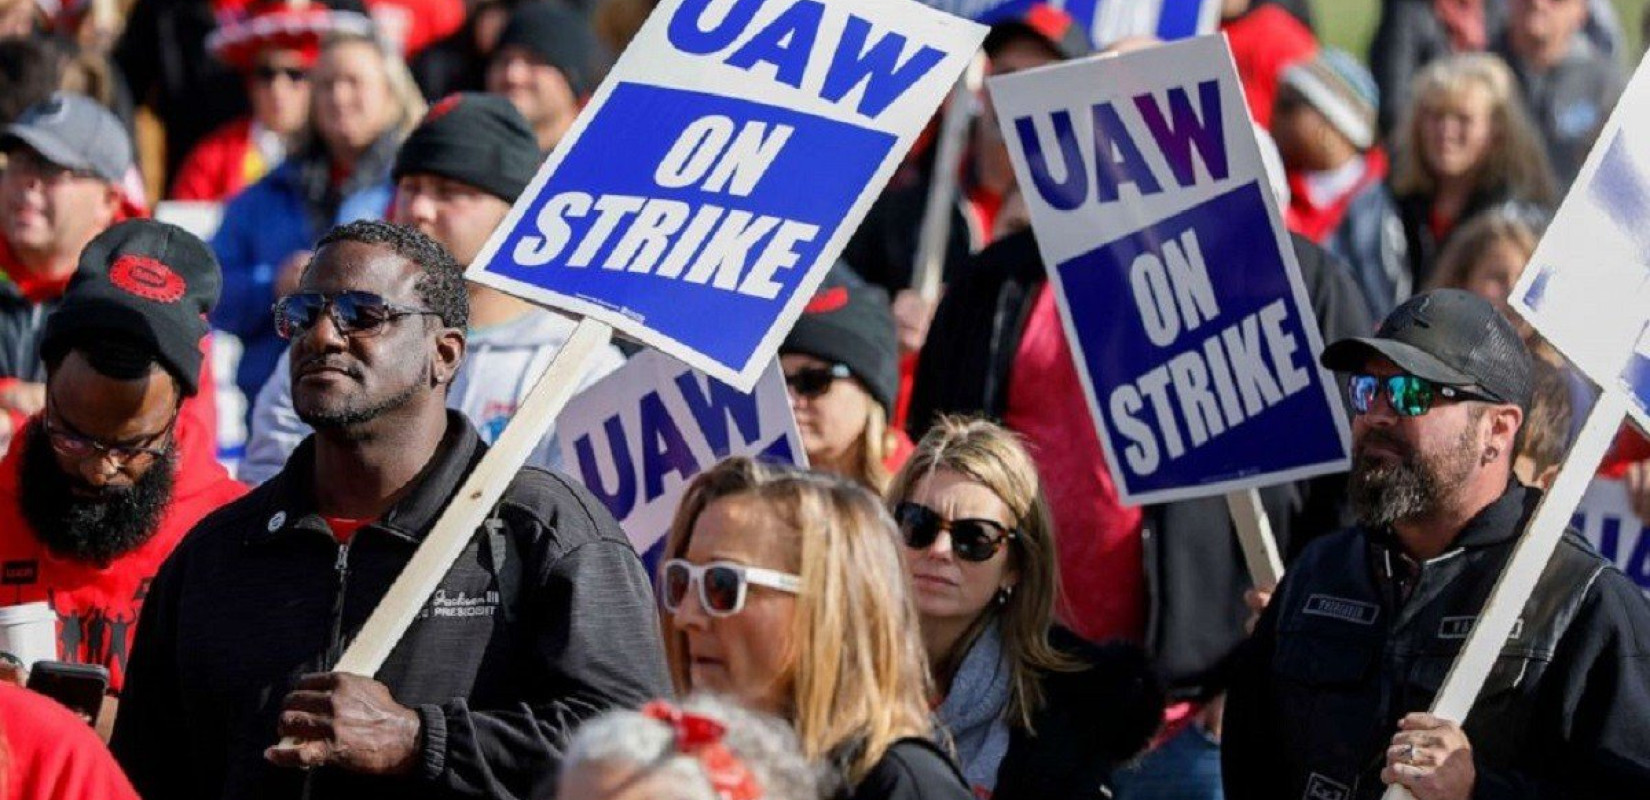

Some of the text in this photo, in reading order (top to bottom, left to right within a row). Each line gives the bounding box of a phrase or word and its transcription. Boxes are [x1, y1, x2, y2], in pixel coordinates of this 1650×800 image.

[667, 0, 947, 119] UAW
[654, 115, 795, 196] ON
[1014, 79, 1229, 211] UAW
[513, 192, 819, 299] STRIKE
[1129, 227, 1220, 347] ON
[573, 370, 761, 521] UAW
[1110, 298, 1310, 475] STRIKE
